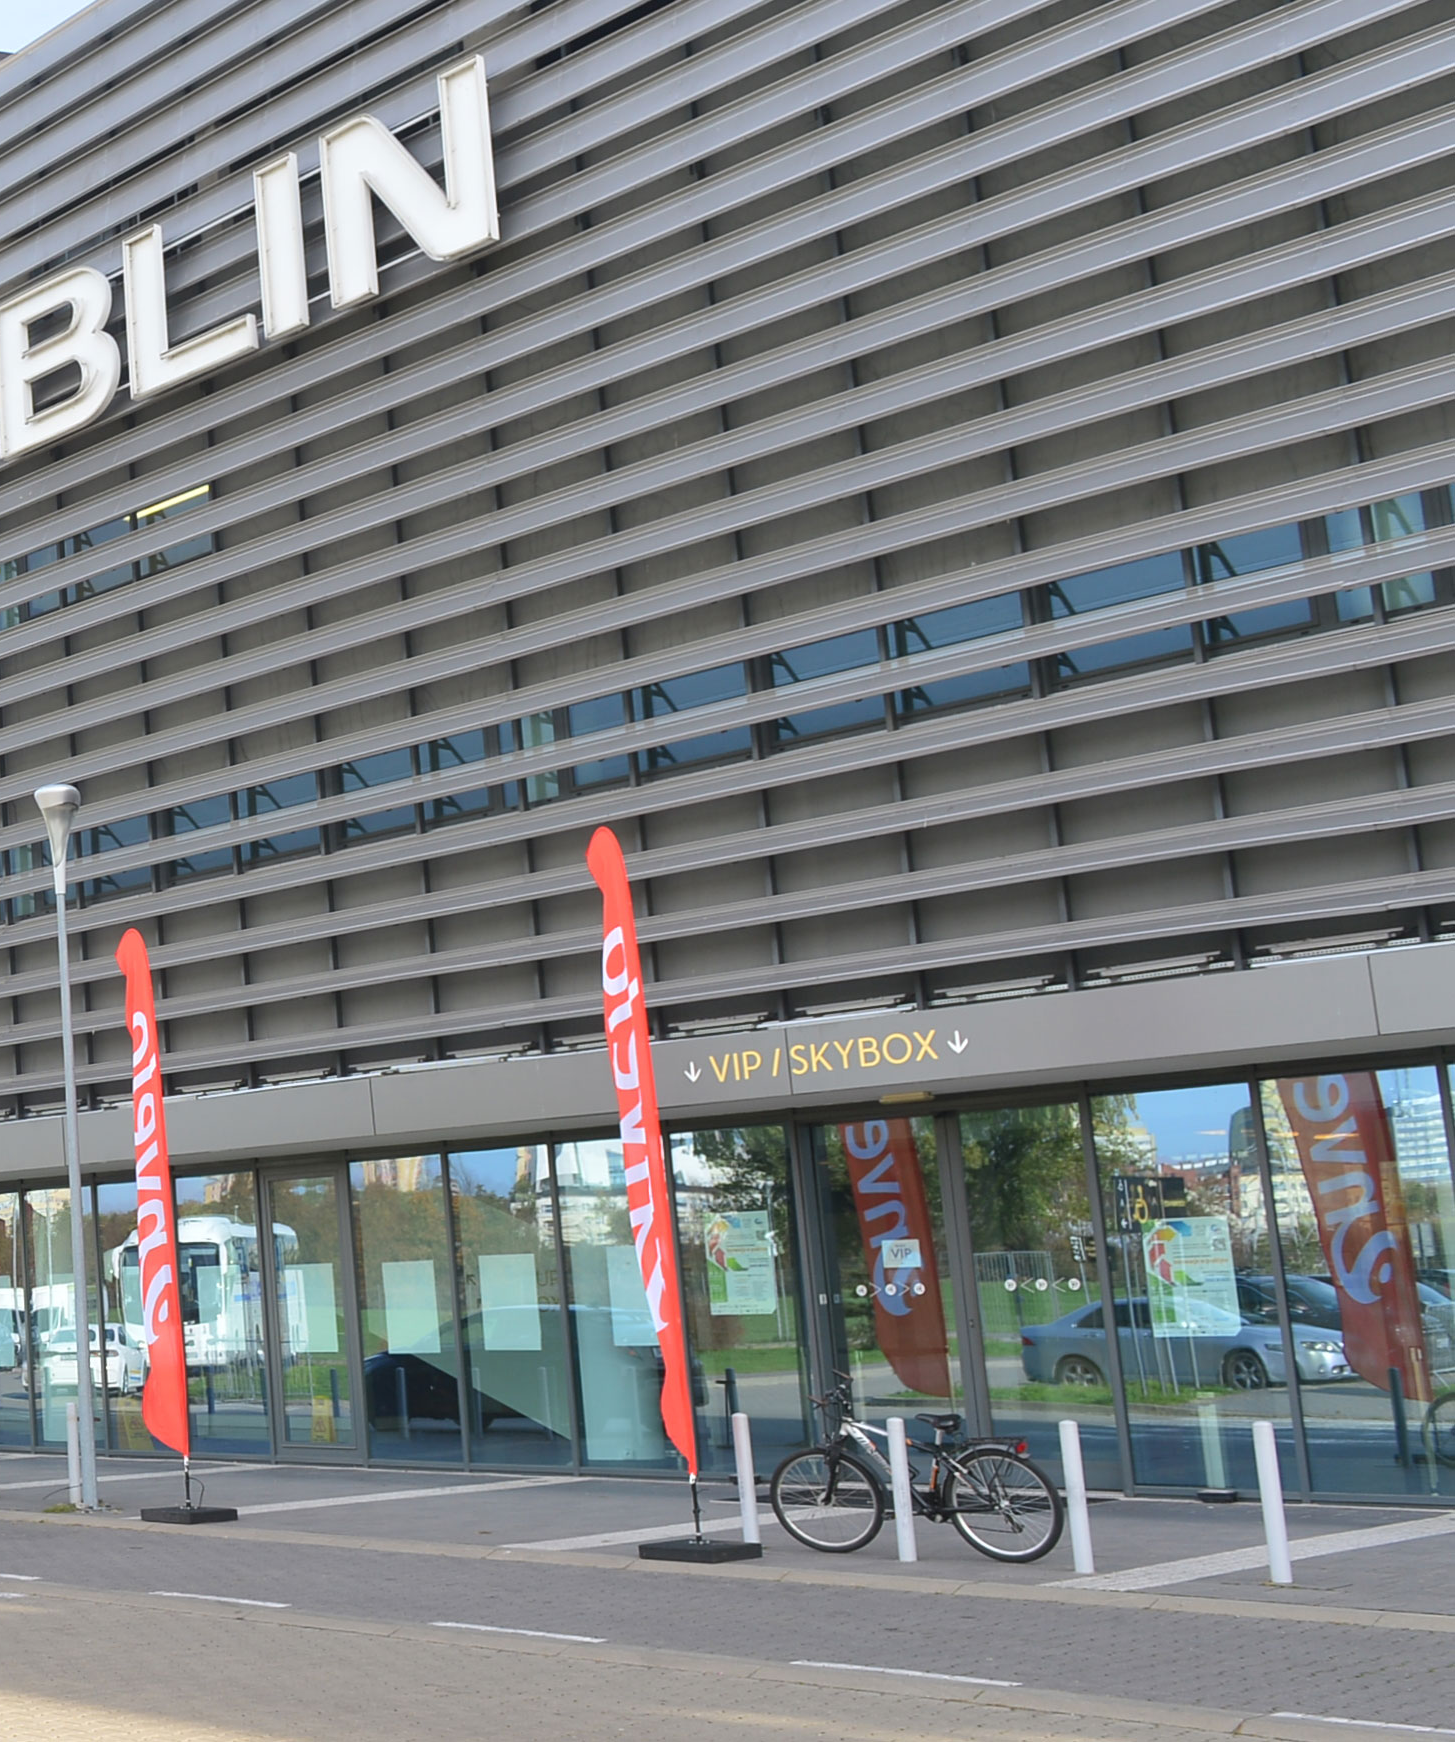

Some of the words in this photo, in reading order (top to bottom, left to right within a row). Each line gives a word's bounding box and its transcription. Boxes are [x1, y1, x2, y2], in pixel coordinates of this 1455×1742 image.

[709, 1050, 762, 1083] VIP
[790, 1029, 939, 1076] SKYBOX
[890, 1247, 912, 1259] VIP
